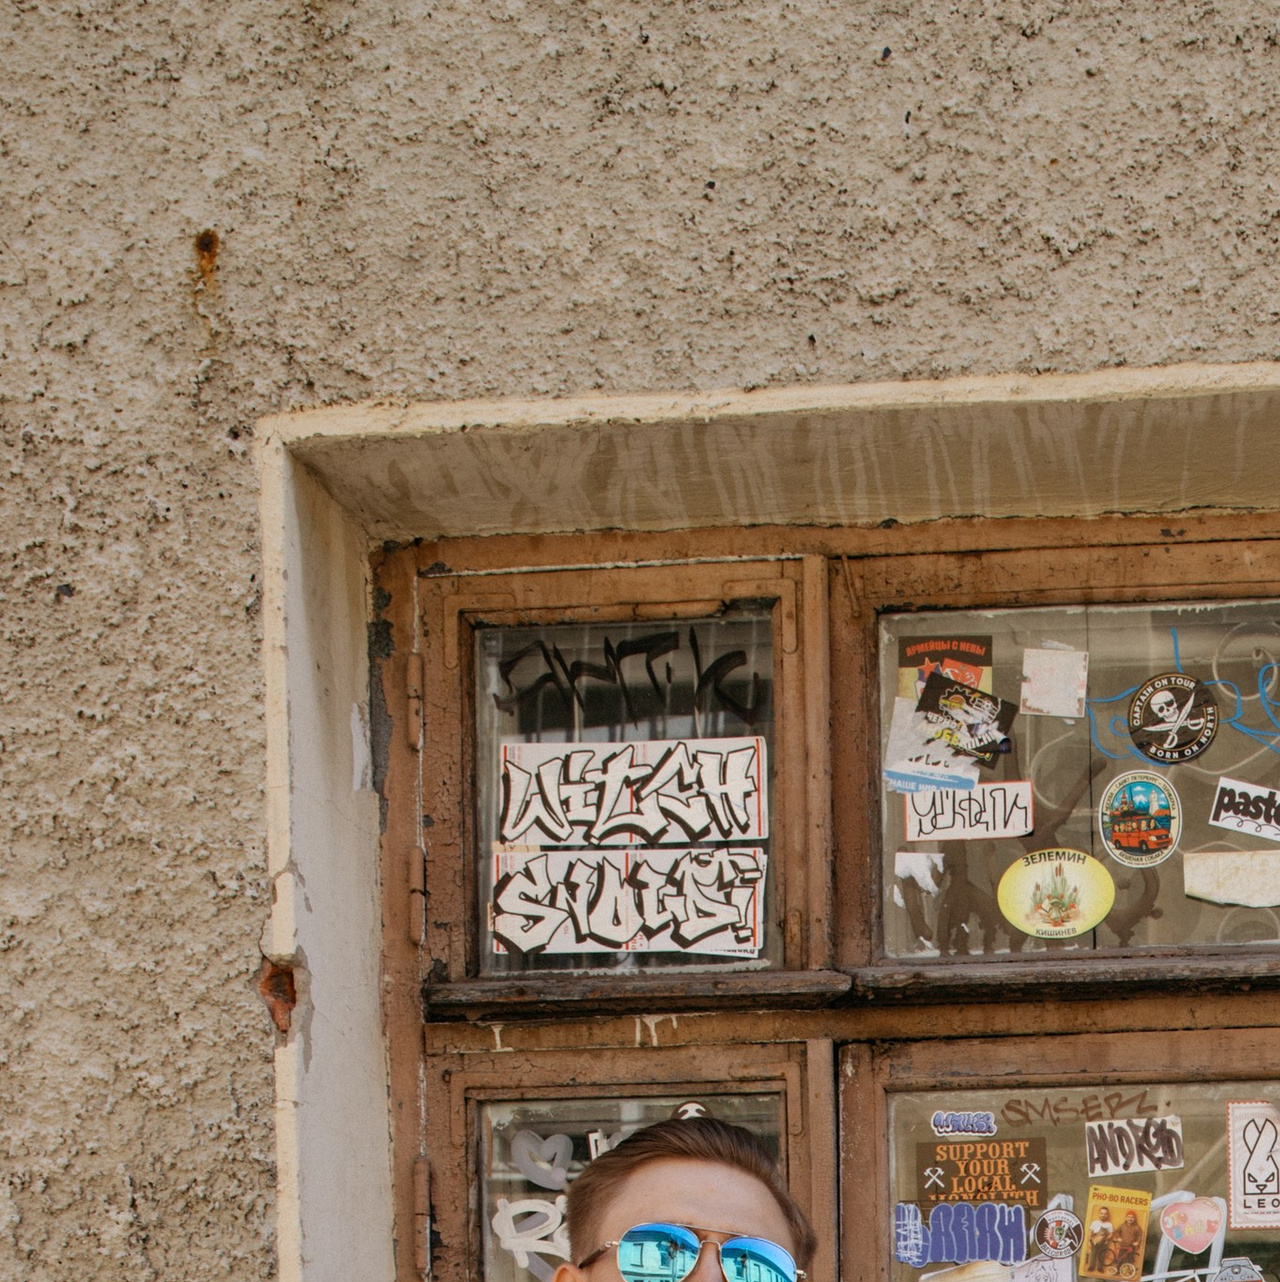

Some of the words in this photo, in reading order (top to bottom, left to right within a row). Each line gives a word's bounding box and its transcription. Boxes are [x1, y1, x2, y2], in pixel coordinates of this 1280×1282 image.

[906, 640, 950, 657] АРМЕЙЦЫ
[959, 641, 986, 657] НЕВЫ
[1133, 685, 1154, 726] CAPTAIN
[1155, 678, 1168, 689] ON
[1170, 677, 1196, 690] TOUR
[1149, 746, 1179, 759] BORN
[1184, 744, 1199, 756] ON
[1200, 706, 1214, 744] NORTH
[1022, 851, 1087, 868] ЗЕЛЕМИН
[1035, 926, 1078, 938] КИШИНЕВ
[935, 1141, 1030, 1162] SUPPORT
[955, 1158, 1011, 1177] YOUR
[951, 1174, 1017, 1194] LOCAL
[1092, 1191, 1120, 1203] PHO-BO
[1120, 1195, 1149, 1207] RACERS
[1243, 1198, 1280, 1209] LEO
